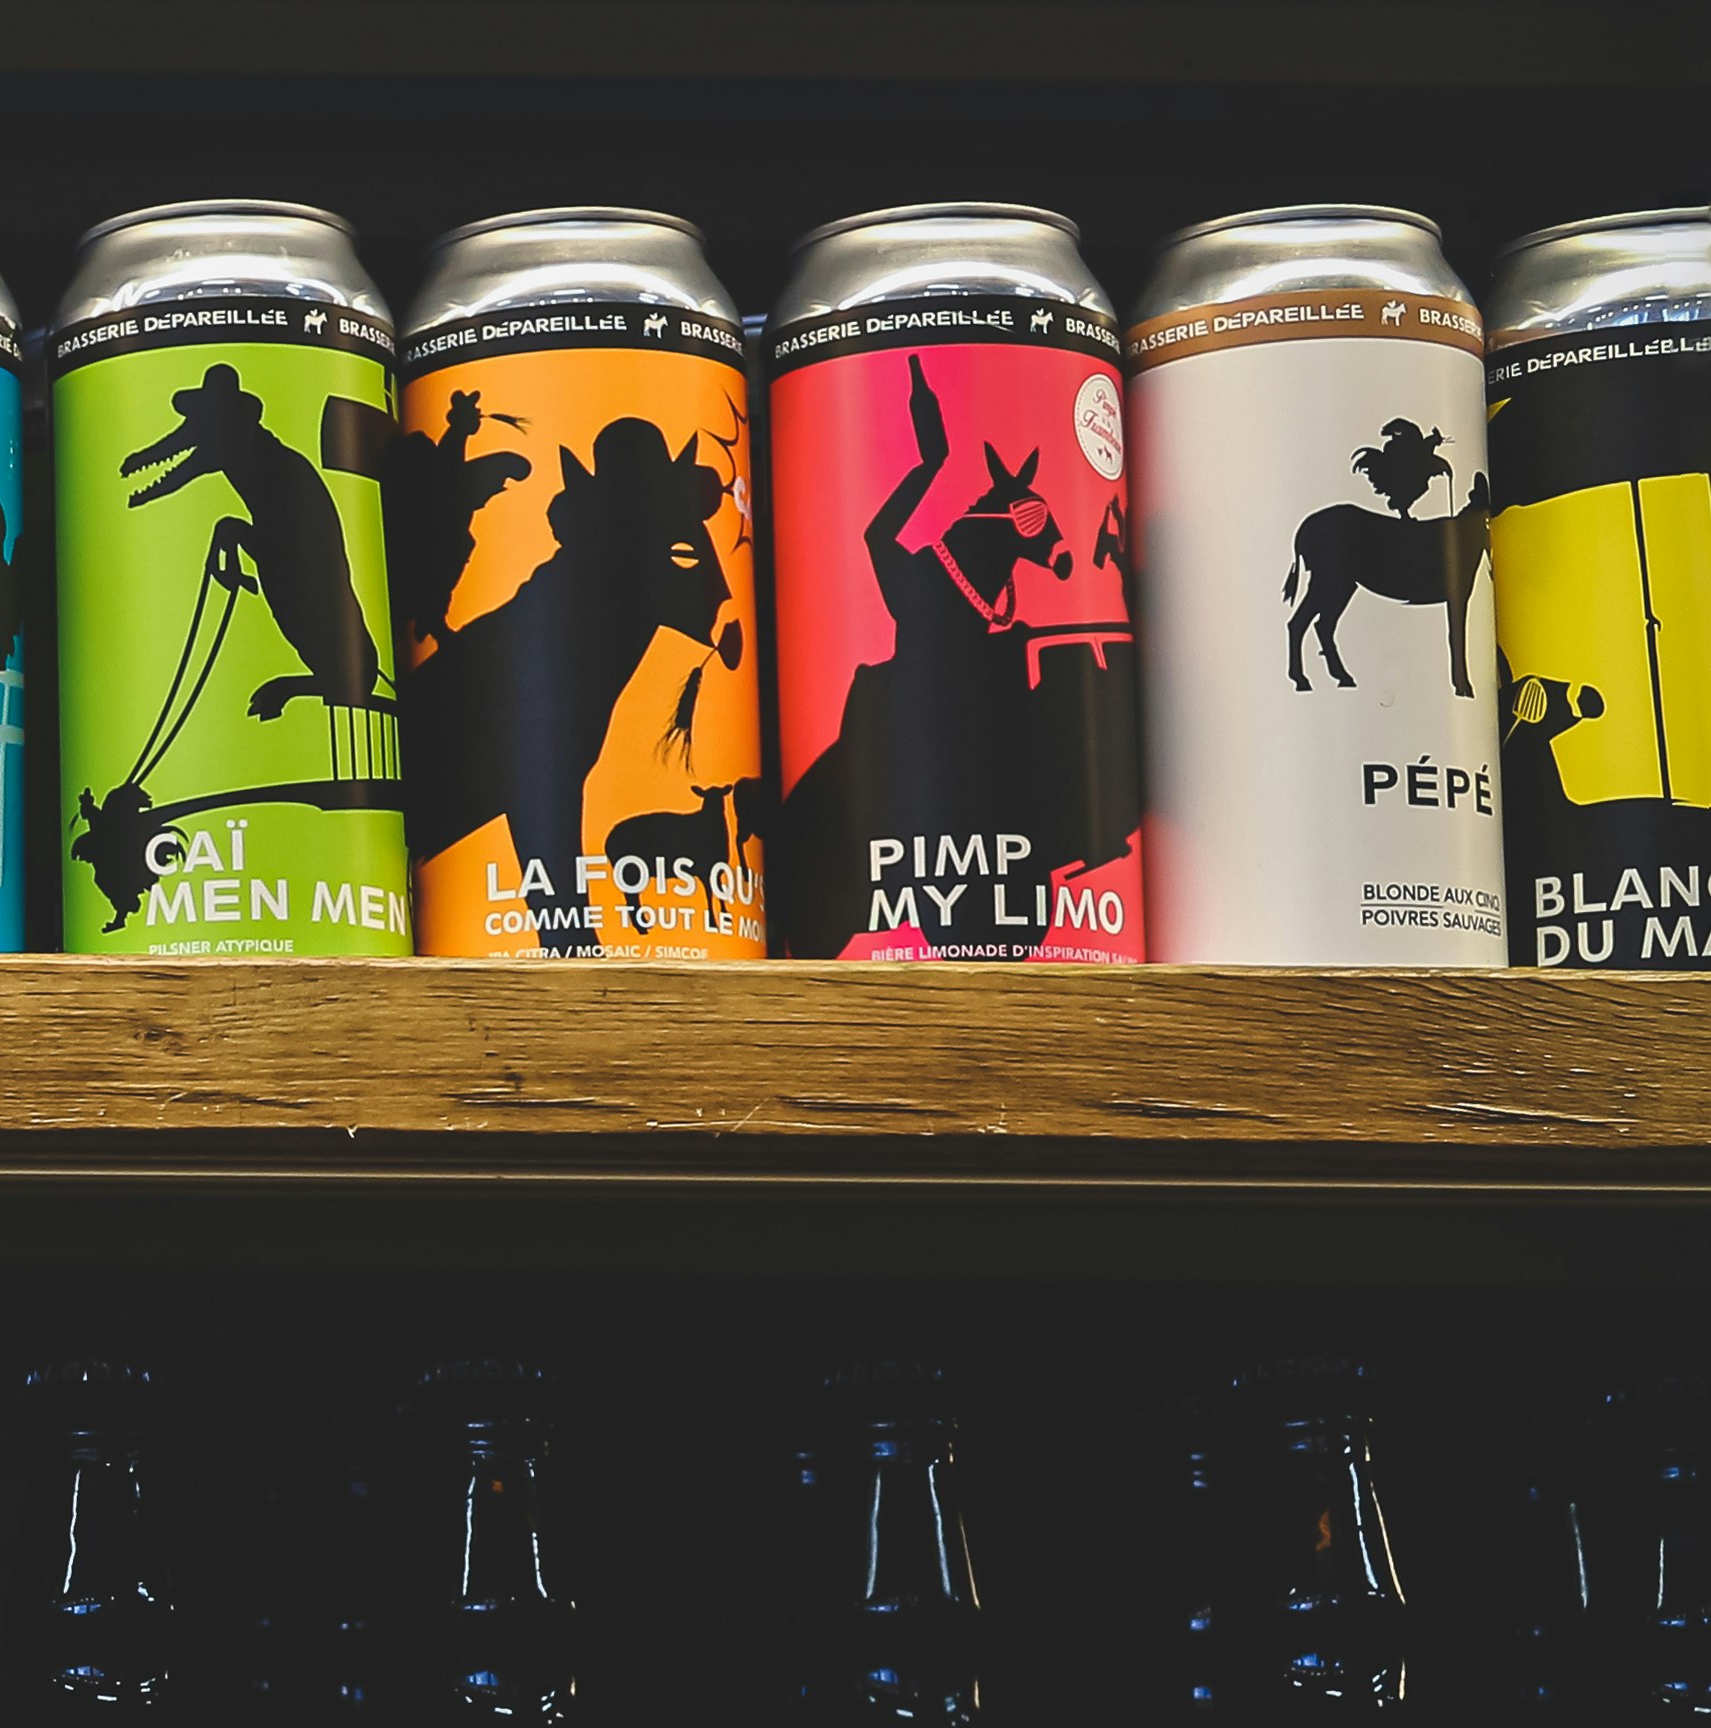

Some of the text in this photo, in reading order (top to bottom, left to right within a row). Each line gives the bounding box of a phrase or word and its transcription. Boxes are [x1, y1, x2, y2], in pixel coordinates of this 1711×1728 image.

[56, 308, 288, 359] BRASSERIE DÉPAREILLÉE
[481, 314, 628, 340] DÉPAREILLÉE
[864, 309, 1015, 336] DÉPAREILLÉE
[1213, 302, 1365, 334] DÉPAREILLÉE
[1362, 753, 1494, 817] PÉPÉ
[869, 833, 1033, 883] PIMP
[485, 854, 698, 903] LA FOIS
[1363, 883, 1474, 906] BLONDE AUX
[145, 878, 407, 937] MEN MEN
[483, 904, 734, 937] COMME TOUT LE
[867, 883, 1125, 936] MY LIMO
[1361, 909, 1503, 938] POIVRES SAUVAGES
[215, 938, 295, 954] ATYPIQUE
[917, 943, 1008, 961] LIMONADE
[1536, 918, 1616, 968] DU
